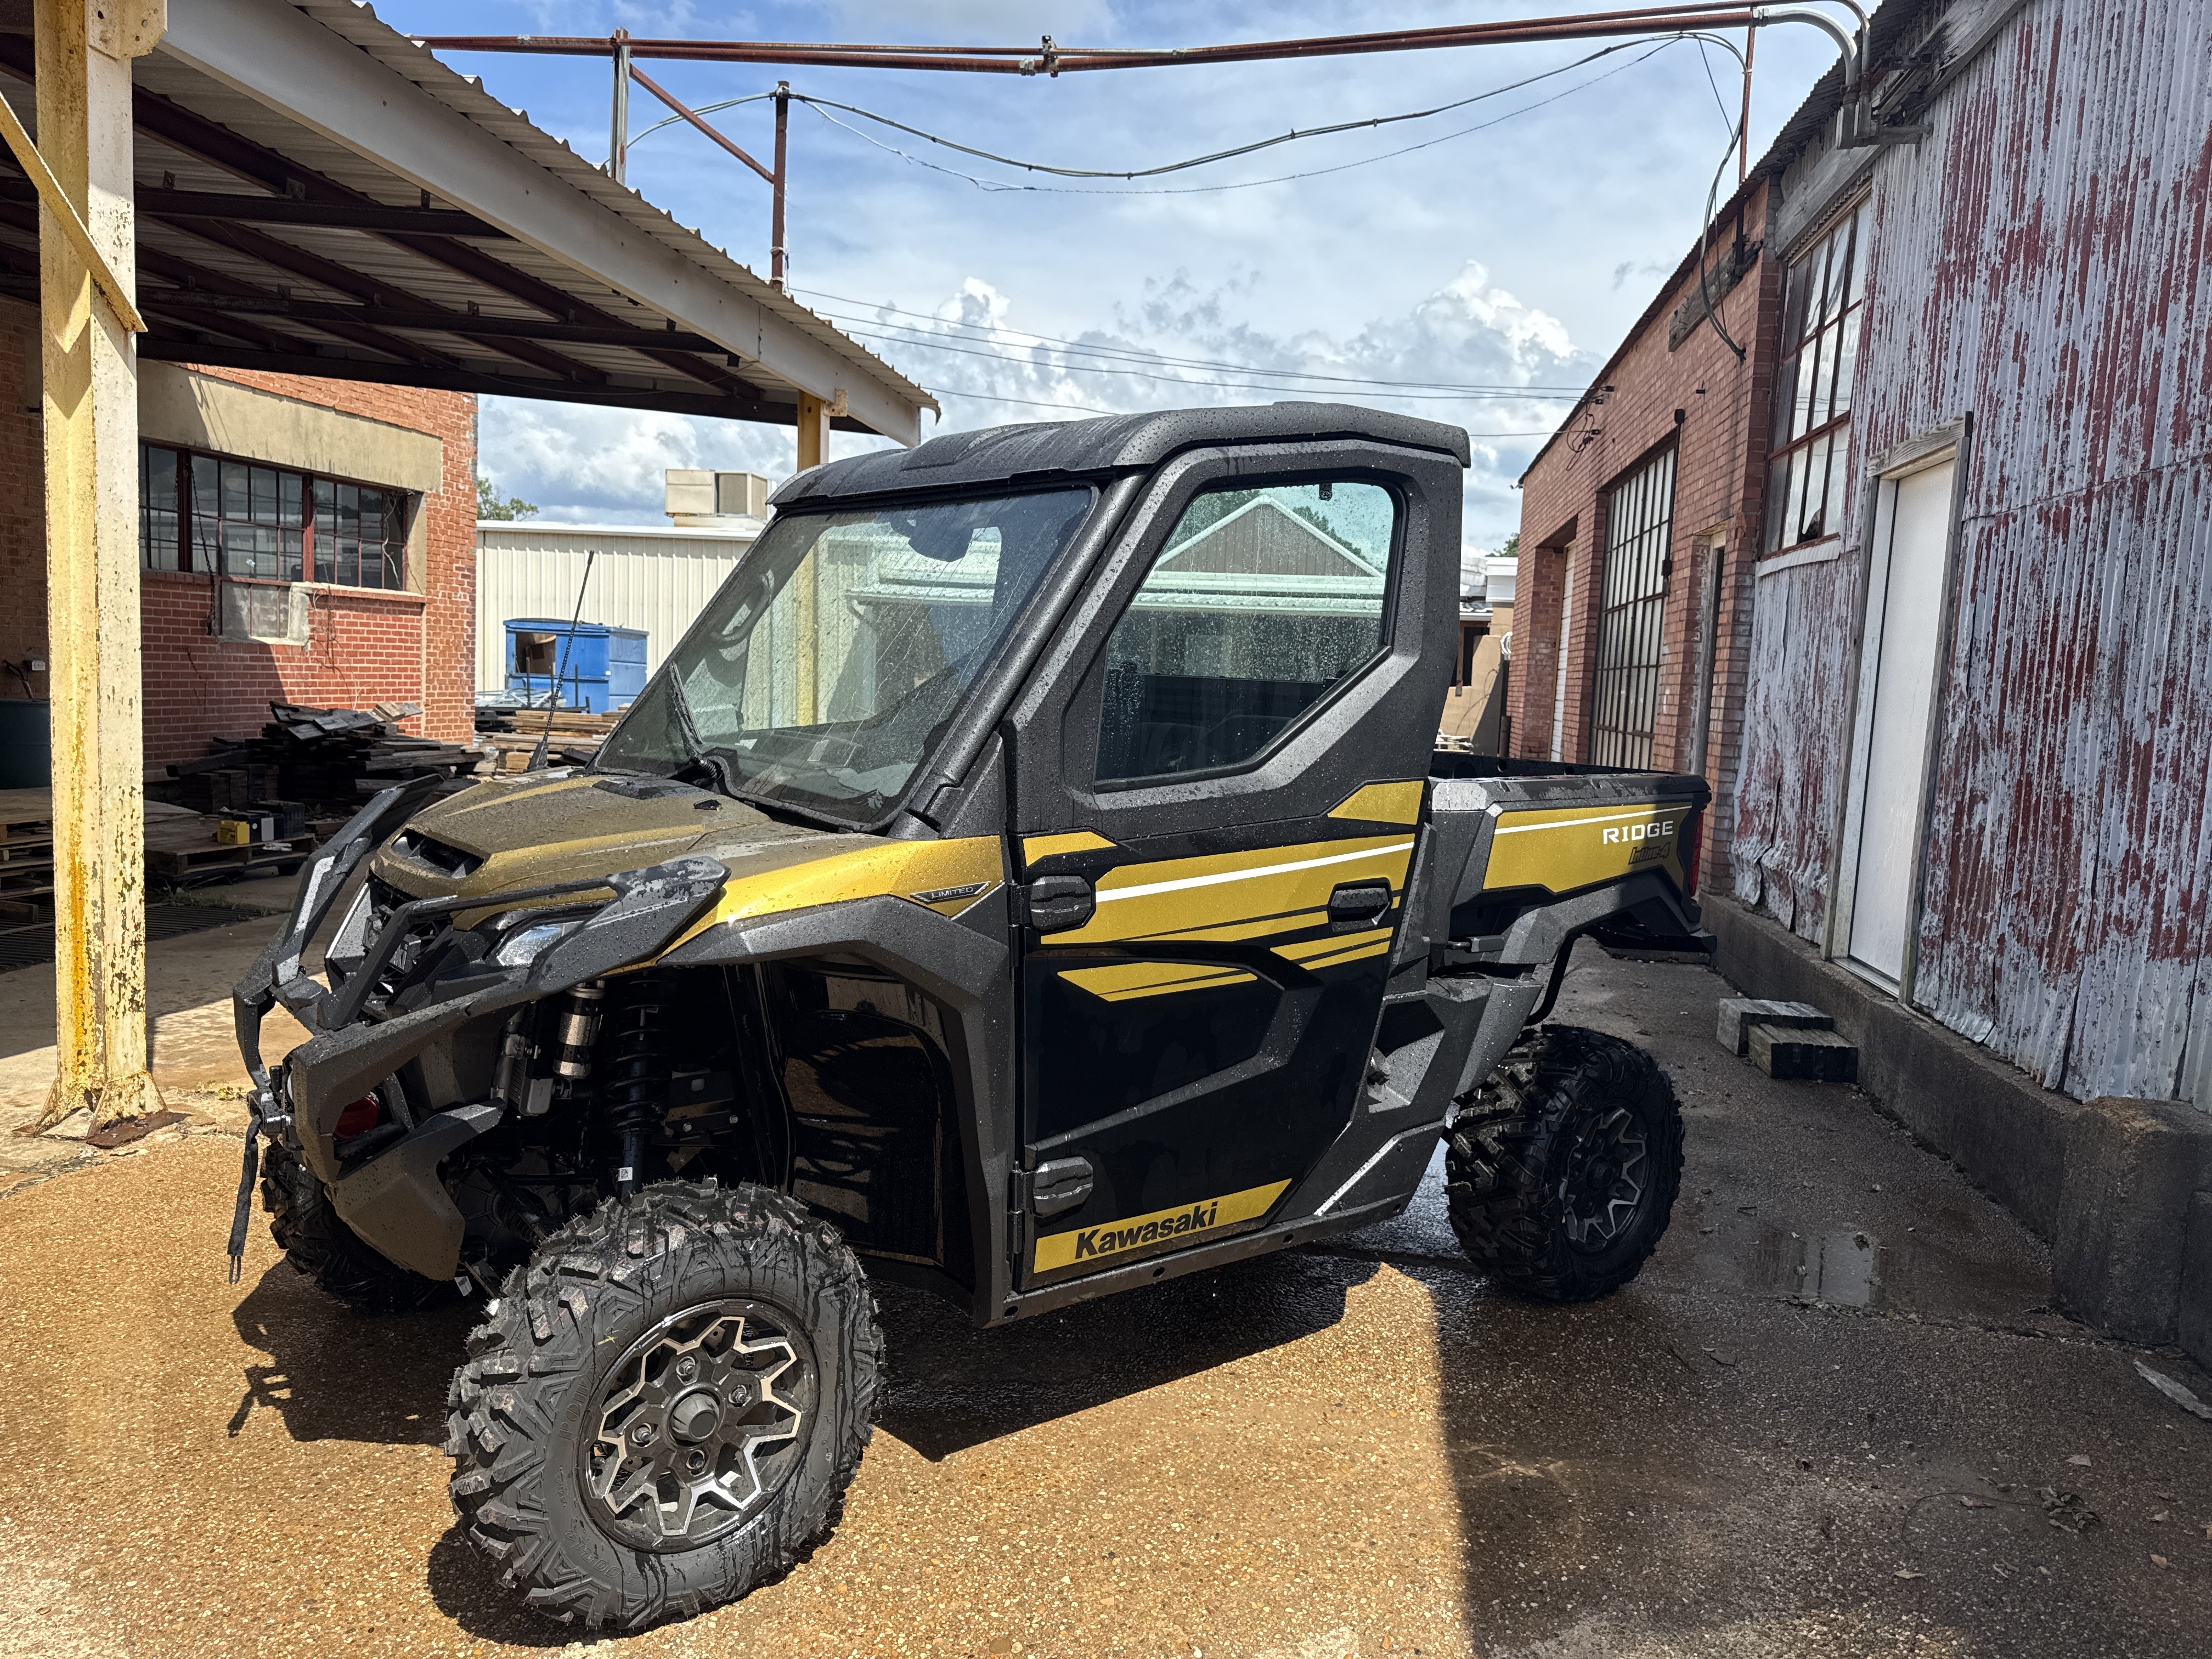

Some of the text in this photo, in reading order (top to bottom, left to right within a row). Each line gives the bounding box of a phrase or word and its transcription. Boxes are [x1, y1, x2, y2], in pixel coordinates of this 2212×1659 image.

[1602, 820, 1673, 844] RIDGE
[931, 887, 973, 899] LIMITED
[1075, 1201, 1218, 1260] Kawasaki
